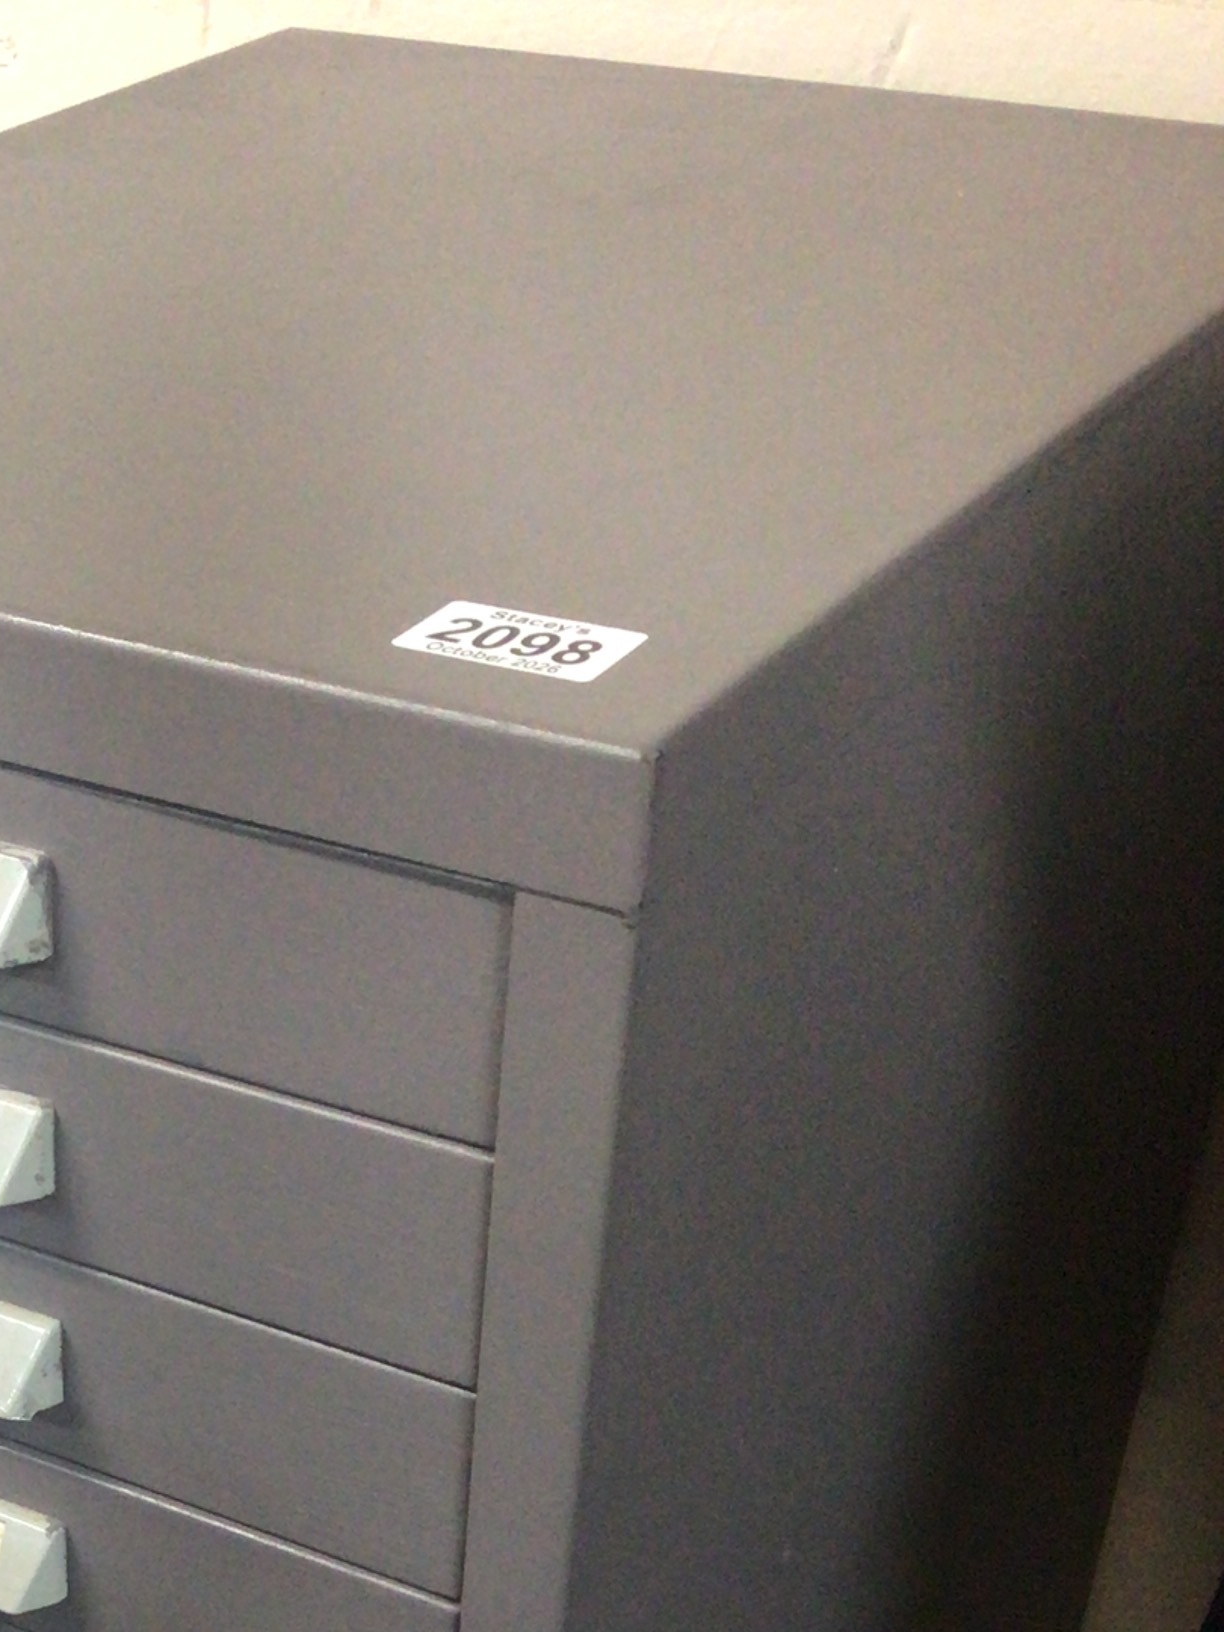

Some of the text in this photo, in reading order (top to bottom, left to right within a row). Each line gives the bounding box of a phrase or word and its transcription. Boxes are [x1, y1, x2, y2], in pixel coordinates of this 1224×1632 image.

[489, 610, 591, 635] Stacey's
[425, 617, 603, 666] 2098
[425, 641, 507, 665] October
